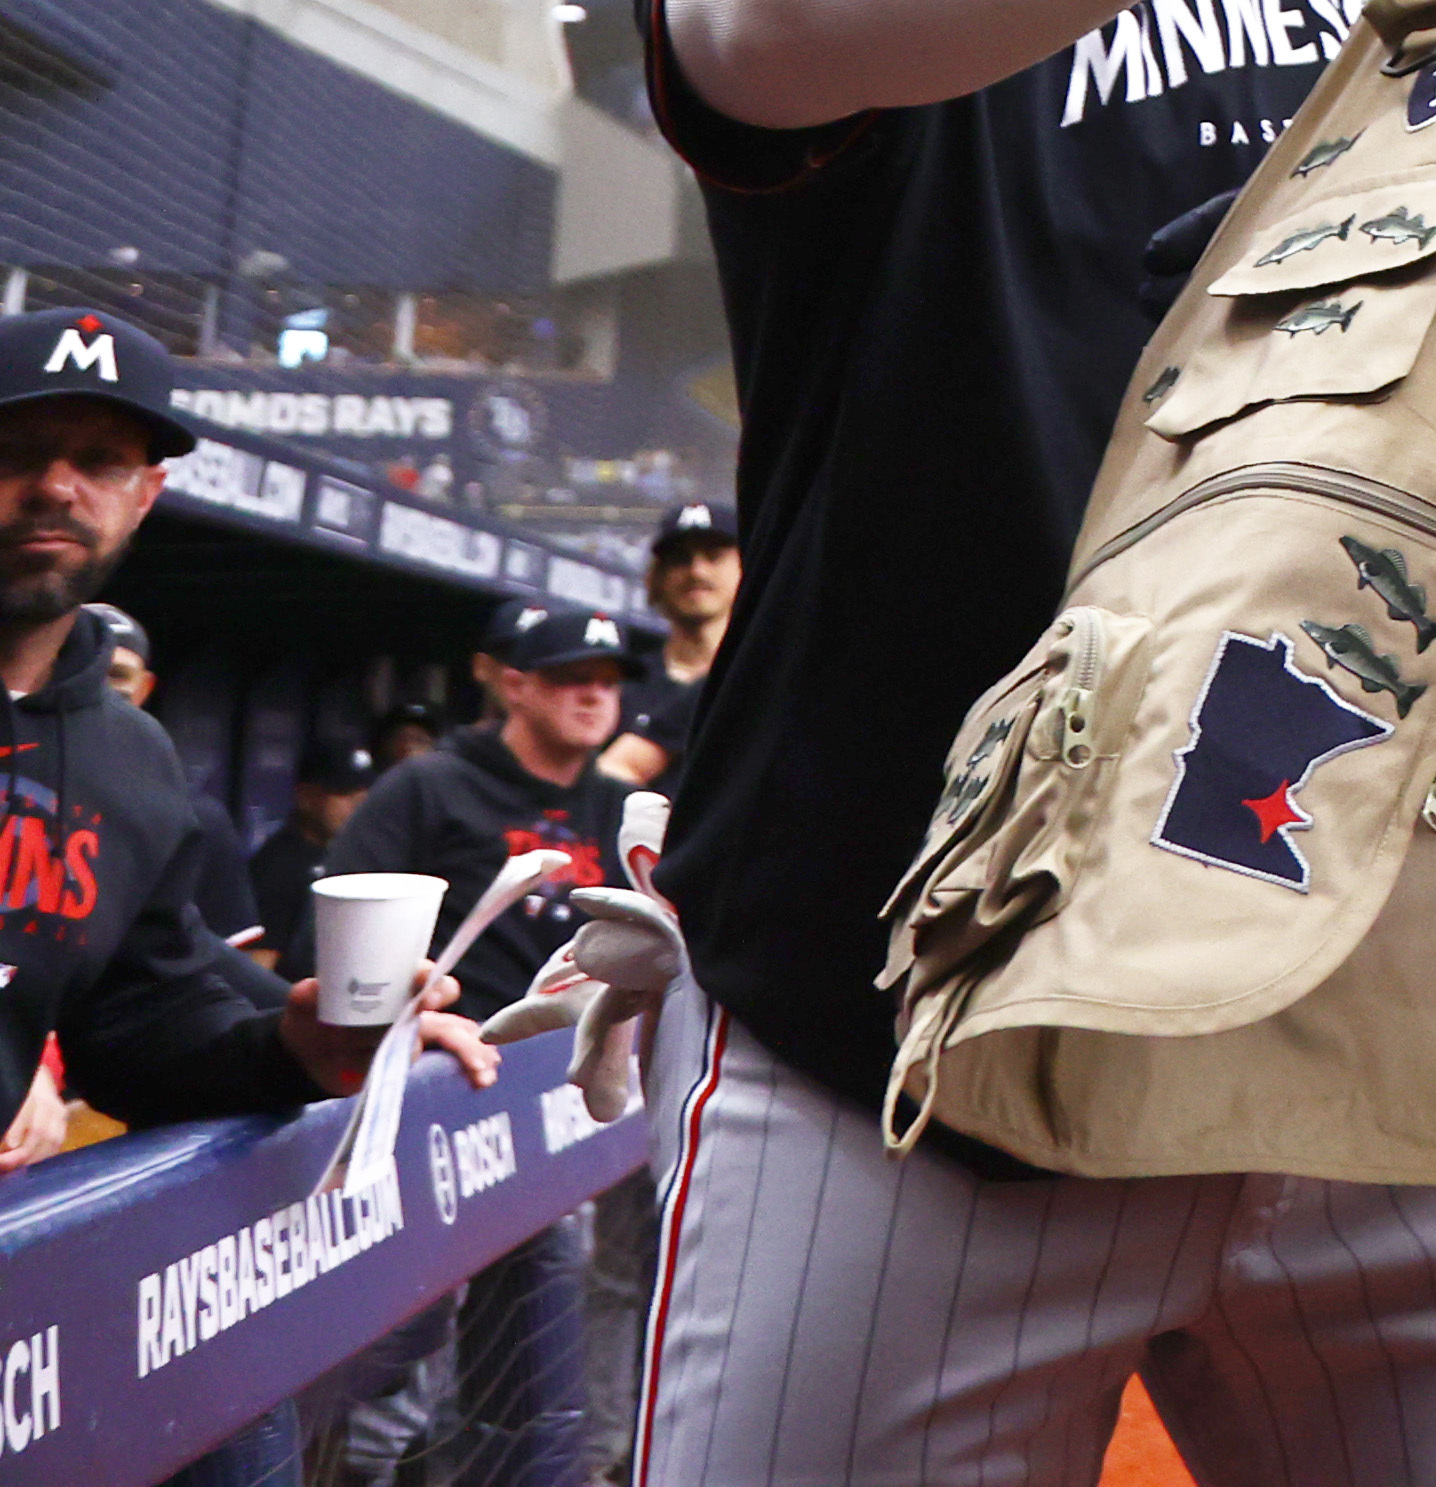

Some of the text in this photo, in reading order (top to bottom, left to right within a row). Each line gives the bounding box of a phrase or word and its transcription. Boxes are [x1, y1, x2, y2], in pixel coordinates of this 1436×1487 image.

[43, 328, 119, 383] M
[333, 393, 452, 439] RAYS
[453, 1111, 518, 1199] BOSCH
[0, 1324, 61, 1453] CH
